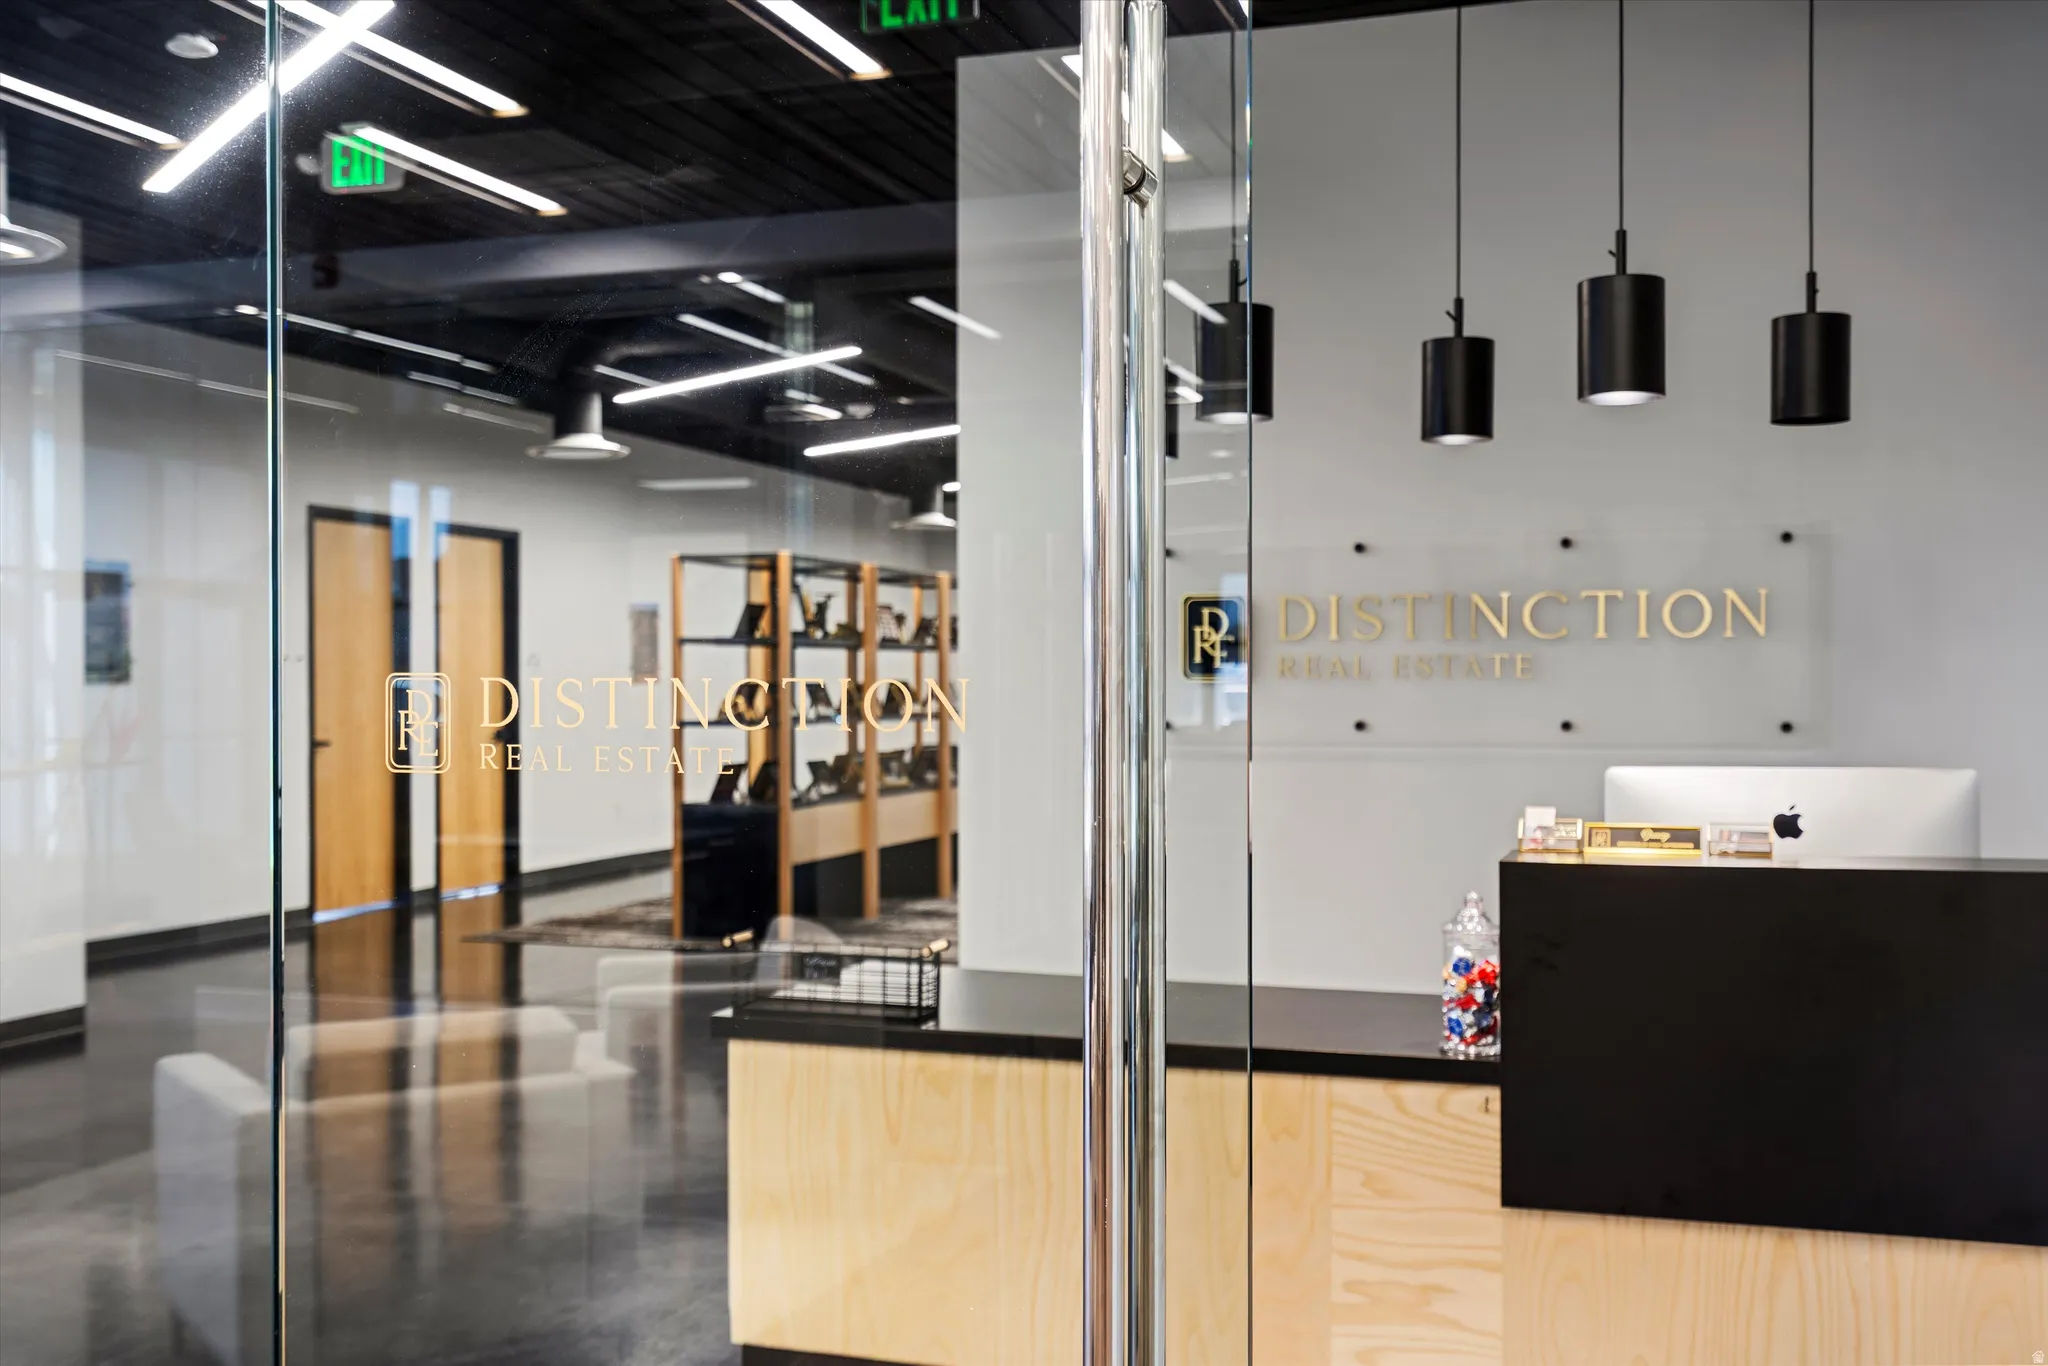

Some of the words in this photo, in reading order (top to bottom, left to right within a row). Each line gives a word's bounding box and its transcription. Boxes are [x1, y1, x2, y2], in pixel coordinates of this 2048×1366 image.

[1279, 588, 1768, 640] DISTINCTION
[1279, 653, 1371, 679] REAL
[1394, 653, 1533, 679] ESTATE
[480, 677, 970, 733] DISTINCTION
[479, 743, 572, 772] REAL
[593, 745, 735, 775] ESTATE
